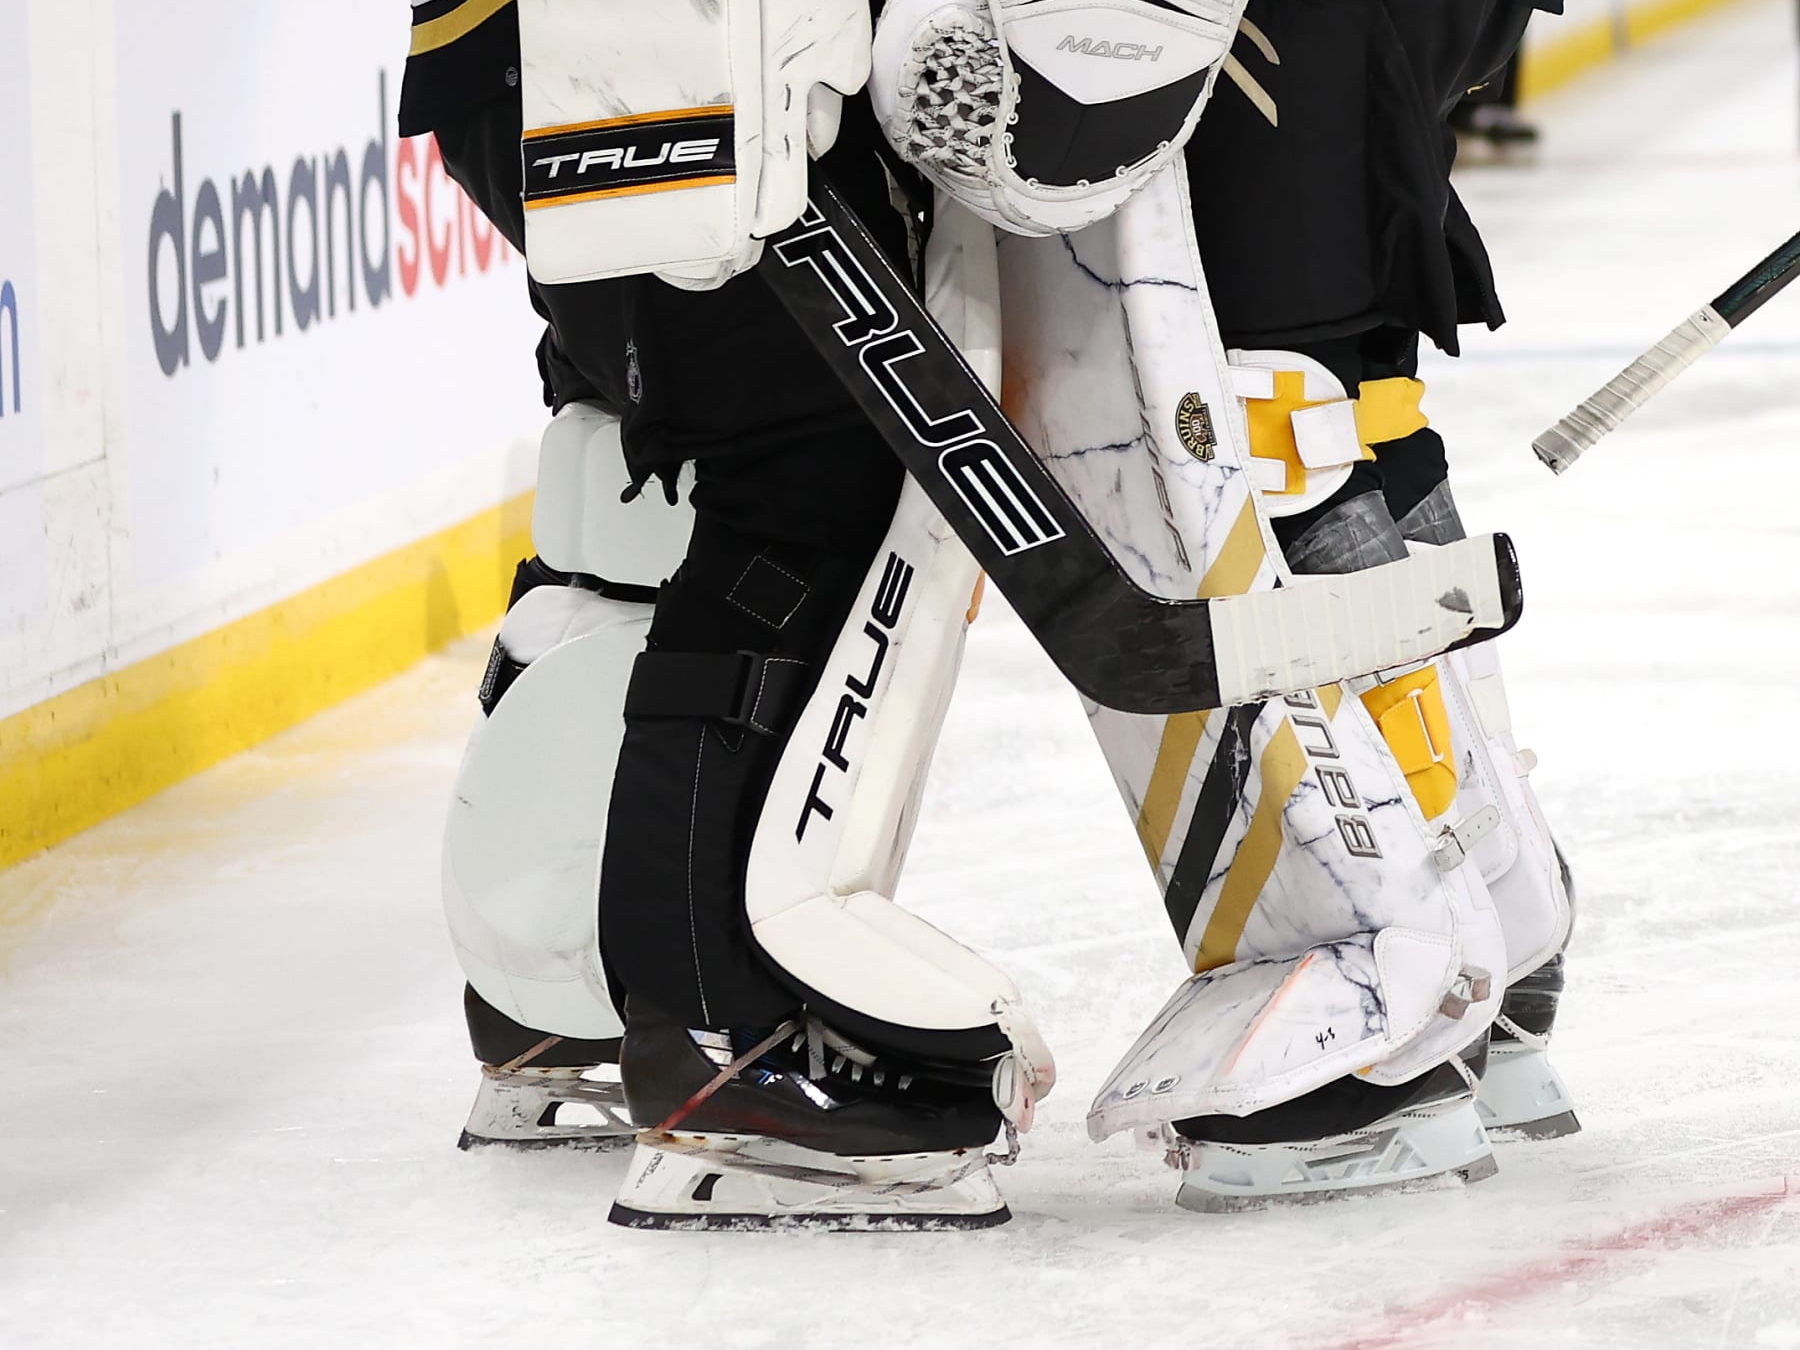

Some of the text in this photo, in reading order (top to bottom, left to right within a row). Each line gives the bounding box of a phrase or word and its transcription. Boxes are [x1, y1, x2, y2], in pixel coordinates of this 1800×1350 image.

[1055, 34, 1164, 62] MACH
[531, 137, 721, 179] TRUE
[772, 196, 1067, 557] RUE
[1179, 400, 1205, 457] BRUINS
[795, 550, 915, 845] TRUE
